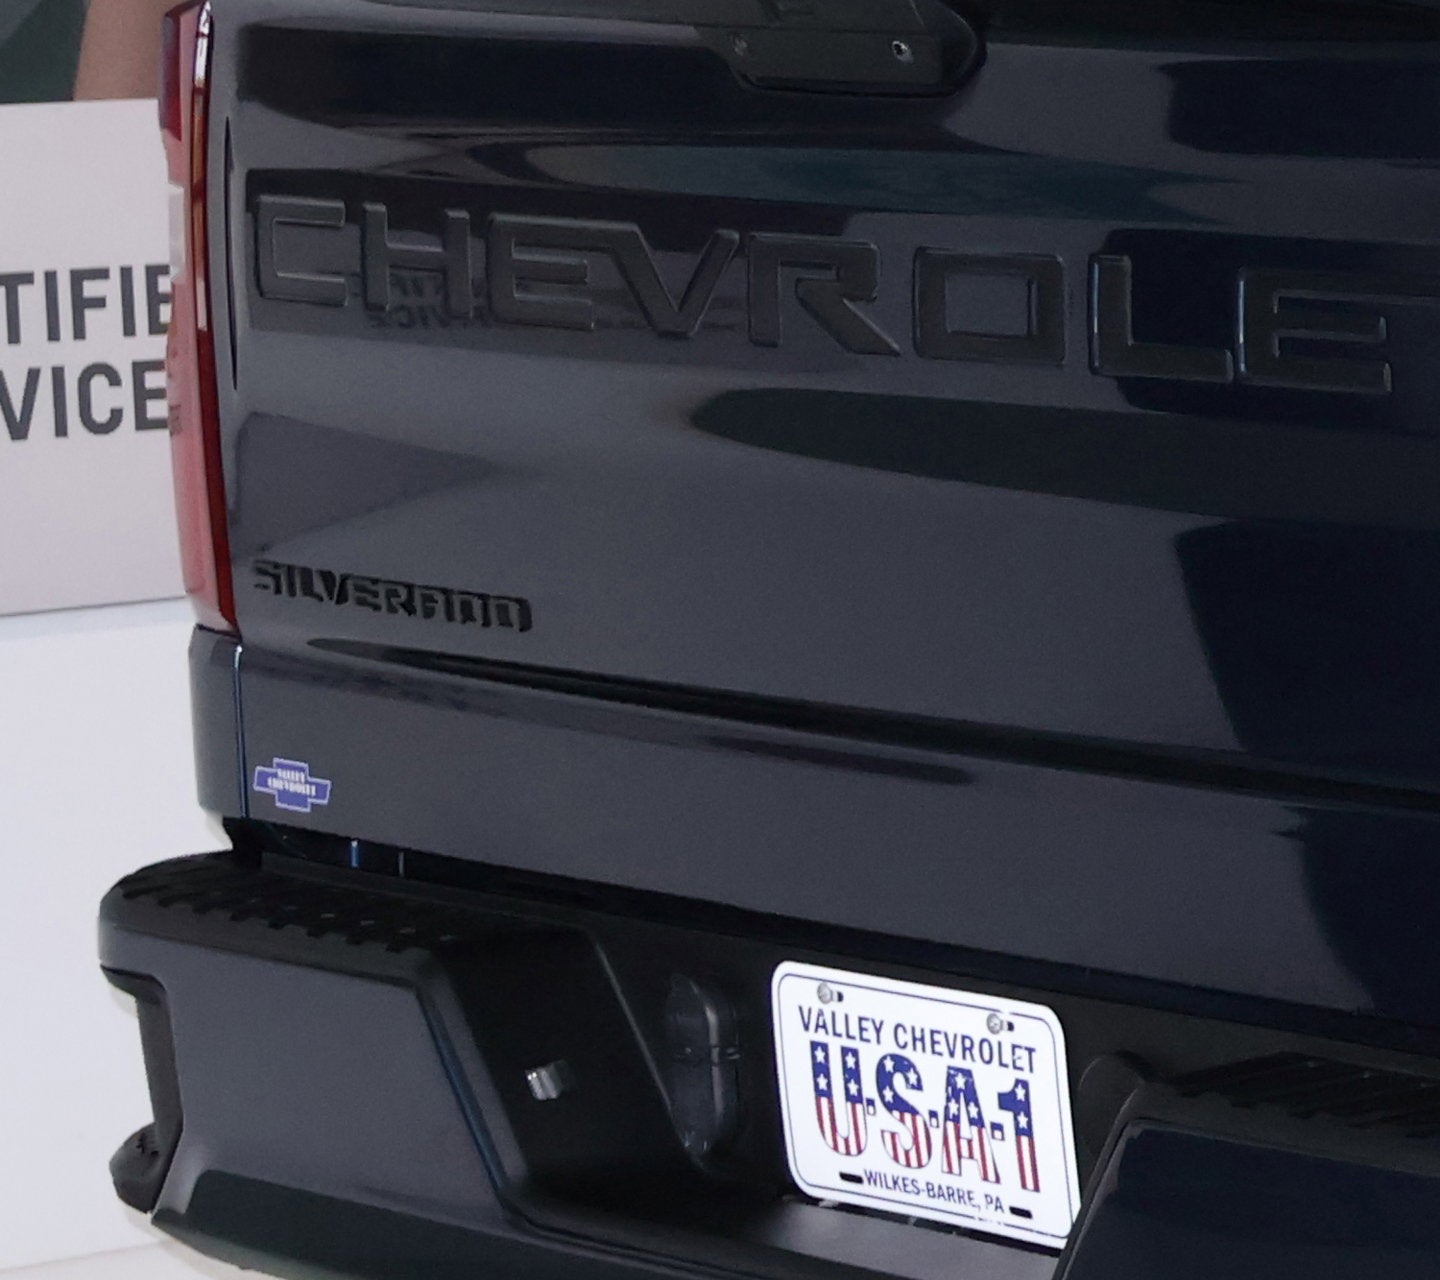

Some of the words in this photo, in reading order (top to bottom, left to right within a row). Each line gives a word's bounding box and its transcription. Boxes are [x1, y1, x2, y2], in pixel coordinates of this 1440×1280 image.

[254, 559, 533, 632] SILVERADO
[797, 1005, 885, 1046] VALLEY
[893, 1022, 1037, 1075] CHEVROLET
[863, 1169, 982, 1212] WILKES-BARRE,
[985, 1194, 1004, 1213] PA
